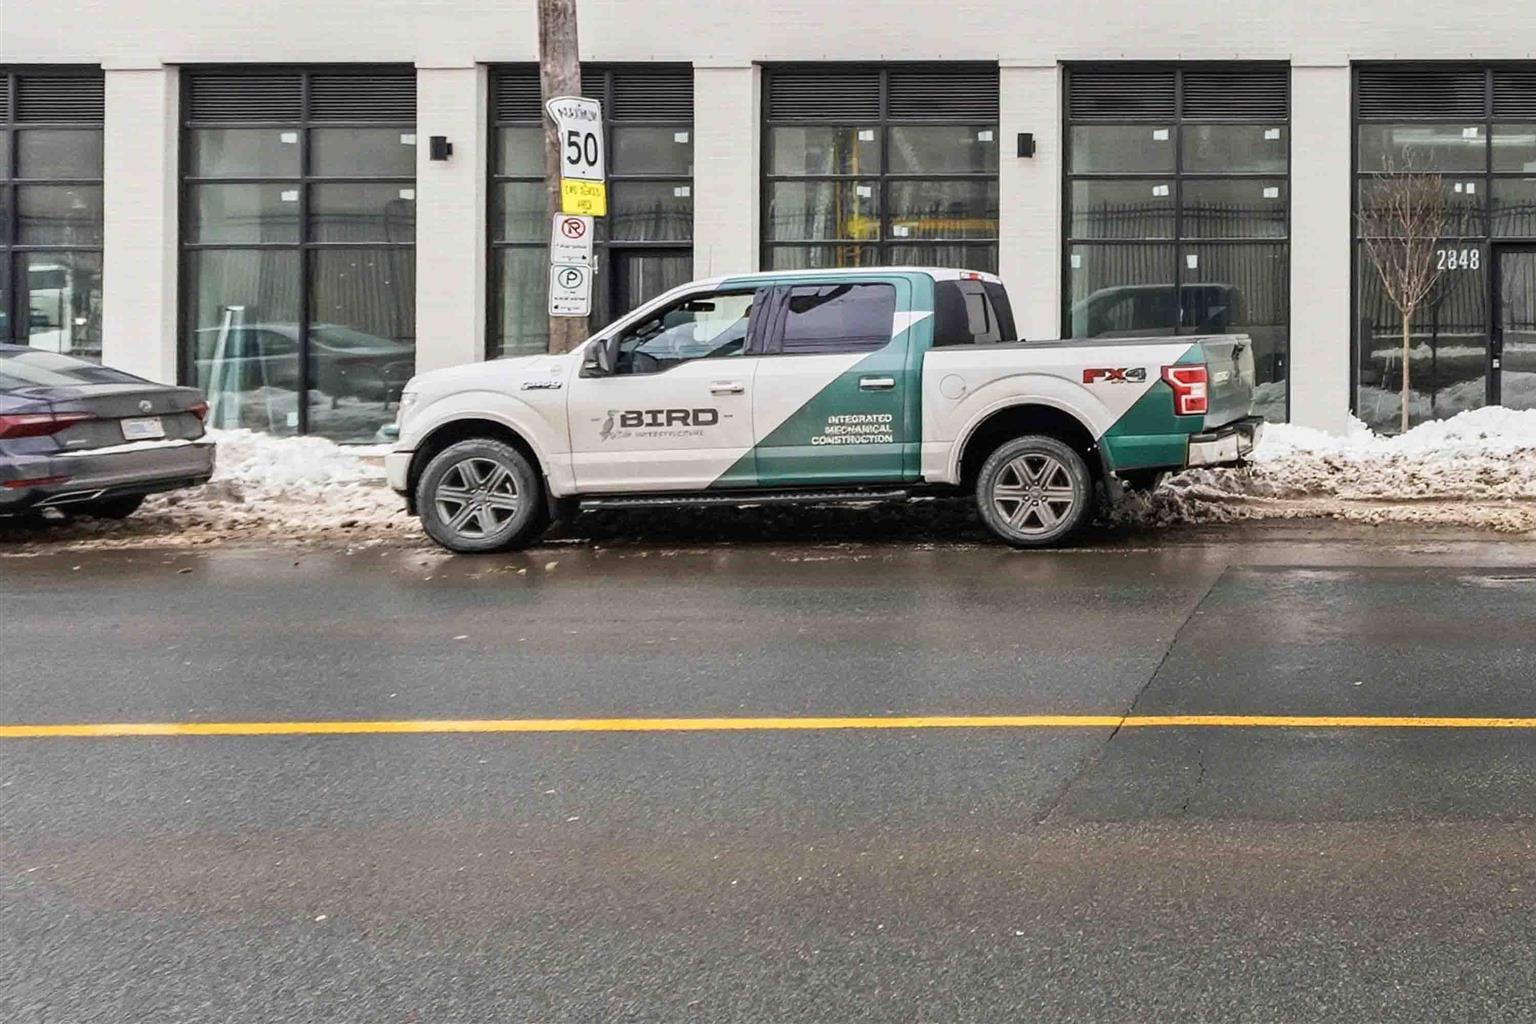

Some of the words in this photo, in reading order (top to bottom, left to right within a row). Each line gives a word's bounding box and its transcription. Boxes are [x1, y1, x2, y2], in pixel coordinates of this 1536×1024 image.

[567, 130, 598, 167] 50
[1436, 249, 1480, 270] 2848
[1083, 367, 1147, 384] FX4
[620, 408, 718, 428] BIRD
[828, 414, 893, 424] INTEGRATED
[824, 424, 893, 434] MECHANICAL
[811, 434, 893, 445] CONSTRUCTION
